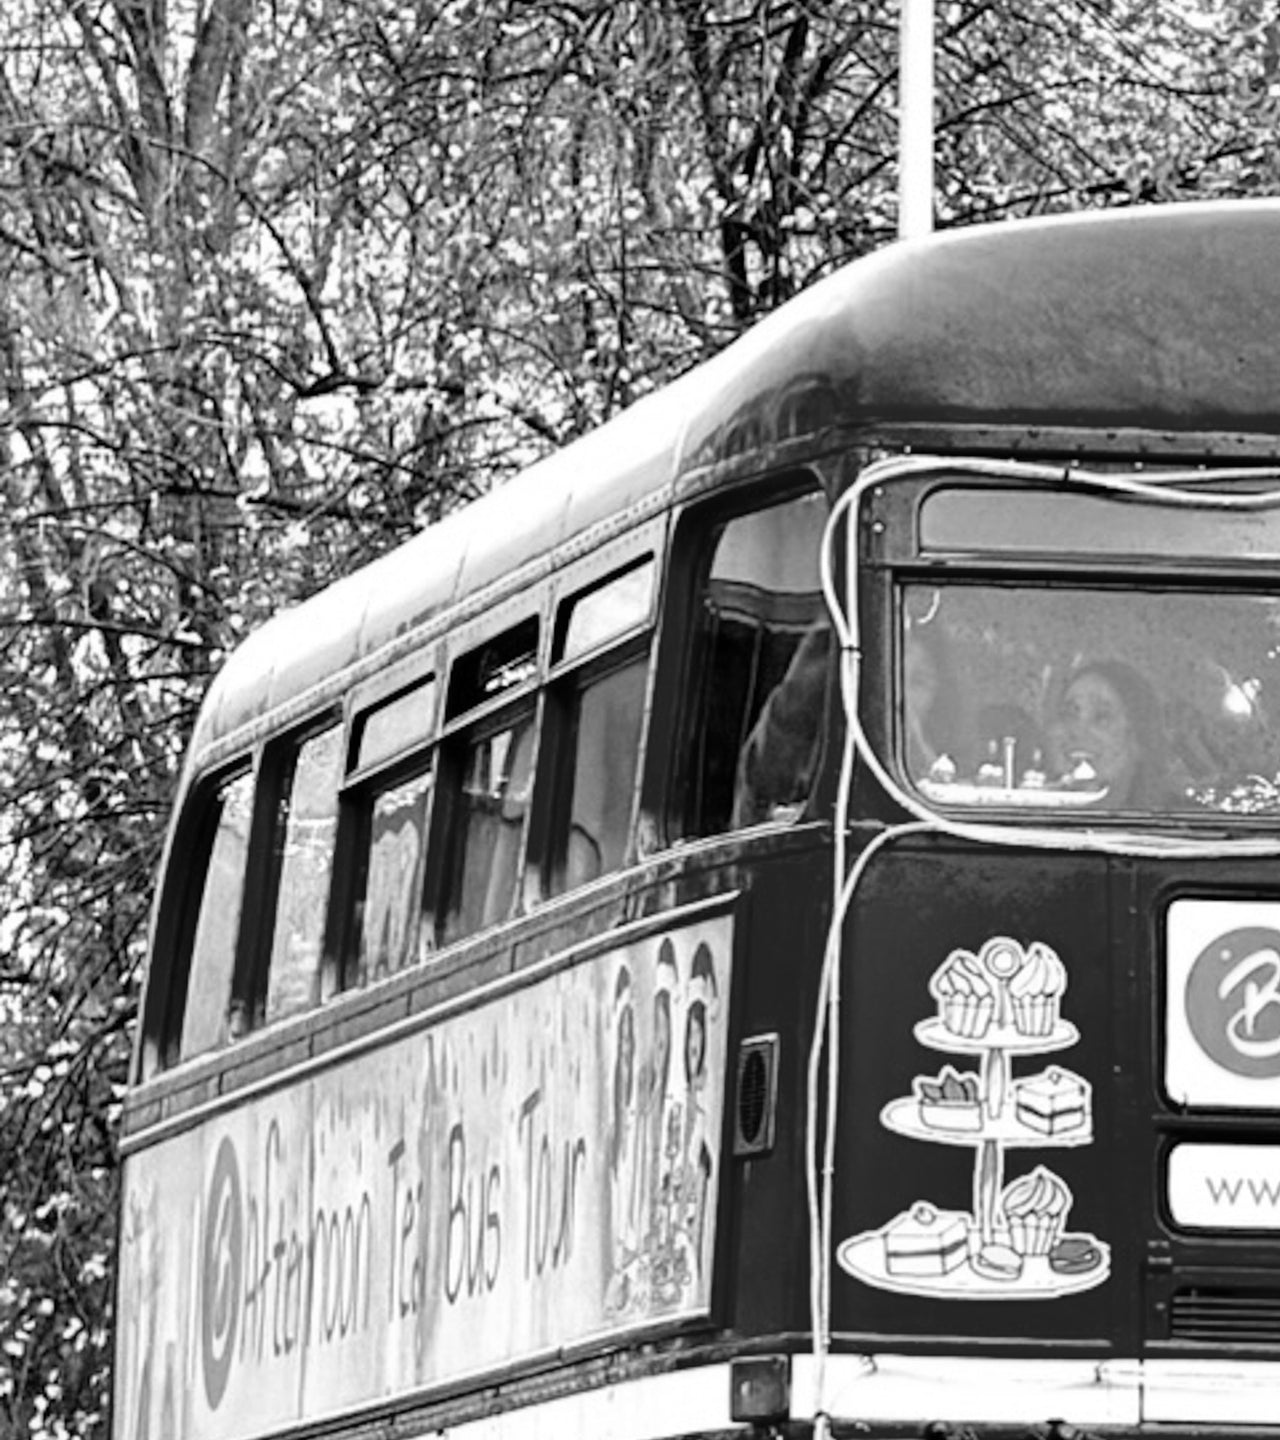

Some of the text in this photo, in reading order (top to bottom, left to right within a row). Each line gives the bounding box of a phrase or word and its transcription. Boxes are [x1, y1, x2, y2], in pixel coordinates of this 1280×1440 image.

[238, 1117, 370, 1364] Afternoon
[445, 1123, 500, 1305] Bus
[518, 1089, 586, 1281] Tour
